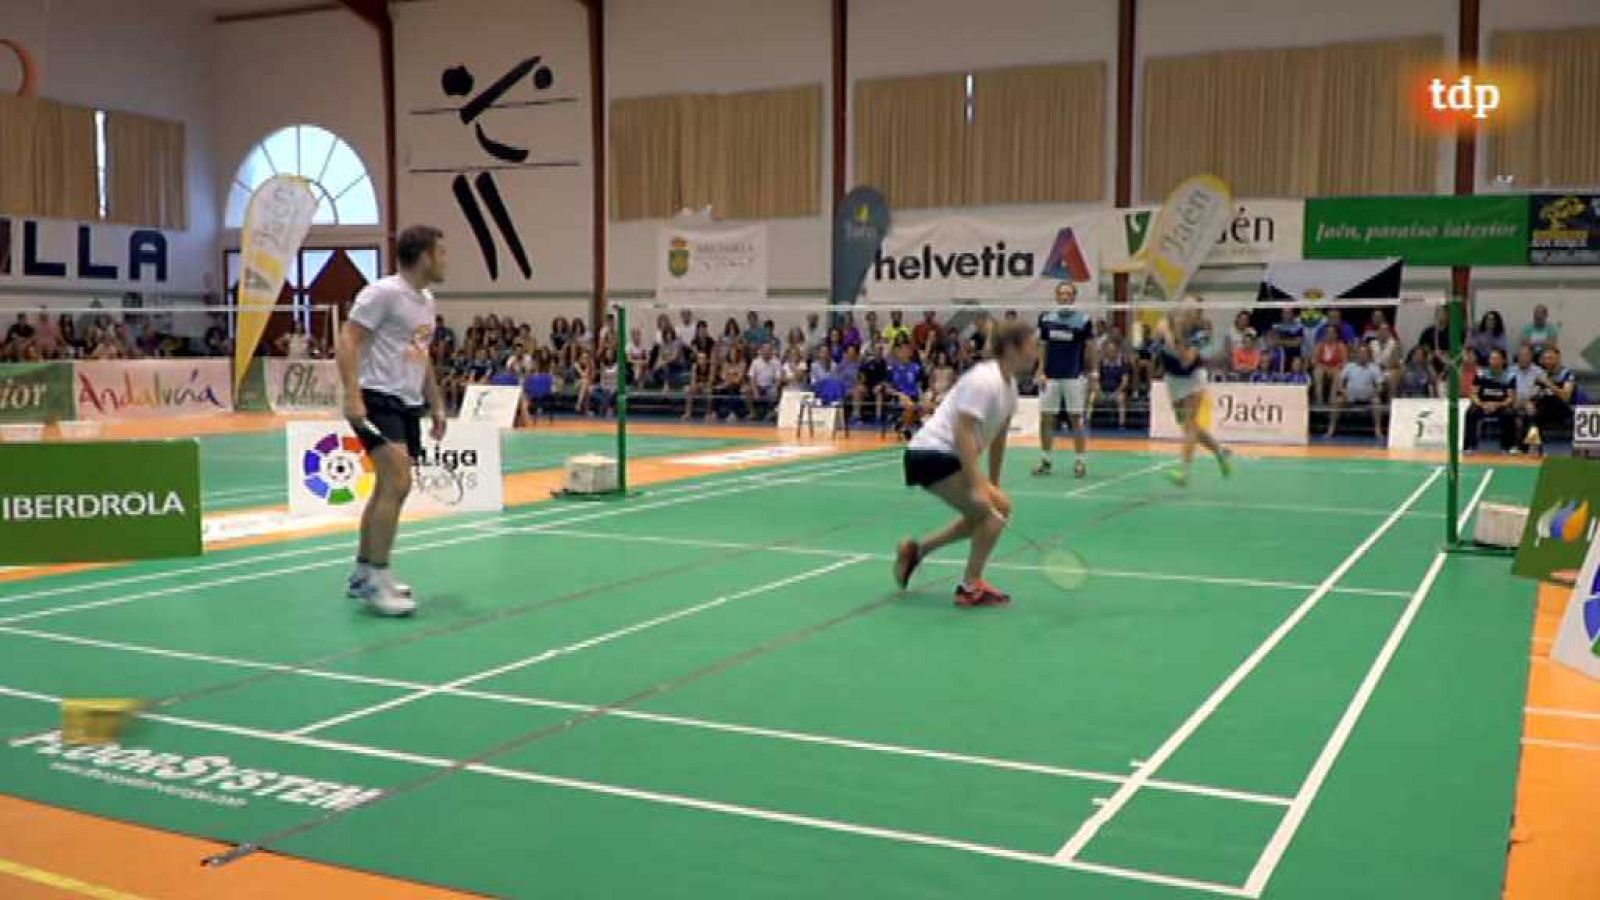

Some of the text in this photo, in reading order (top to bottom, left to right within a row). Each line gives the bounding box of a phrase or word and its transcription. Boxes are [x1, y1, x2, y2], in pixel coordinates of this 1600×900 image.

[874, 241, 1034, 281] helvetia
[78, 368, 225, 413] Andalucía
[1218, 394, 1283, 424] Jaén
[411, 446, 477, 472] Liga
[2, 491, 186, 520] IBERDROLA
